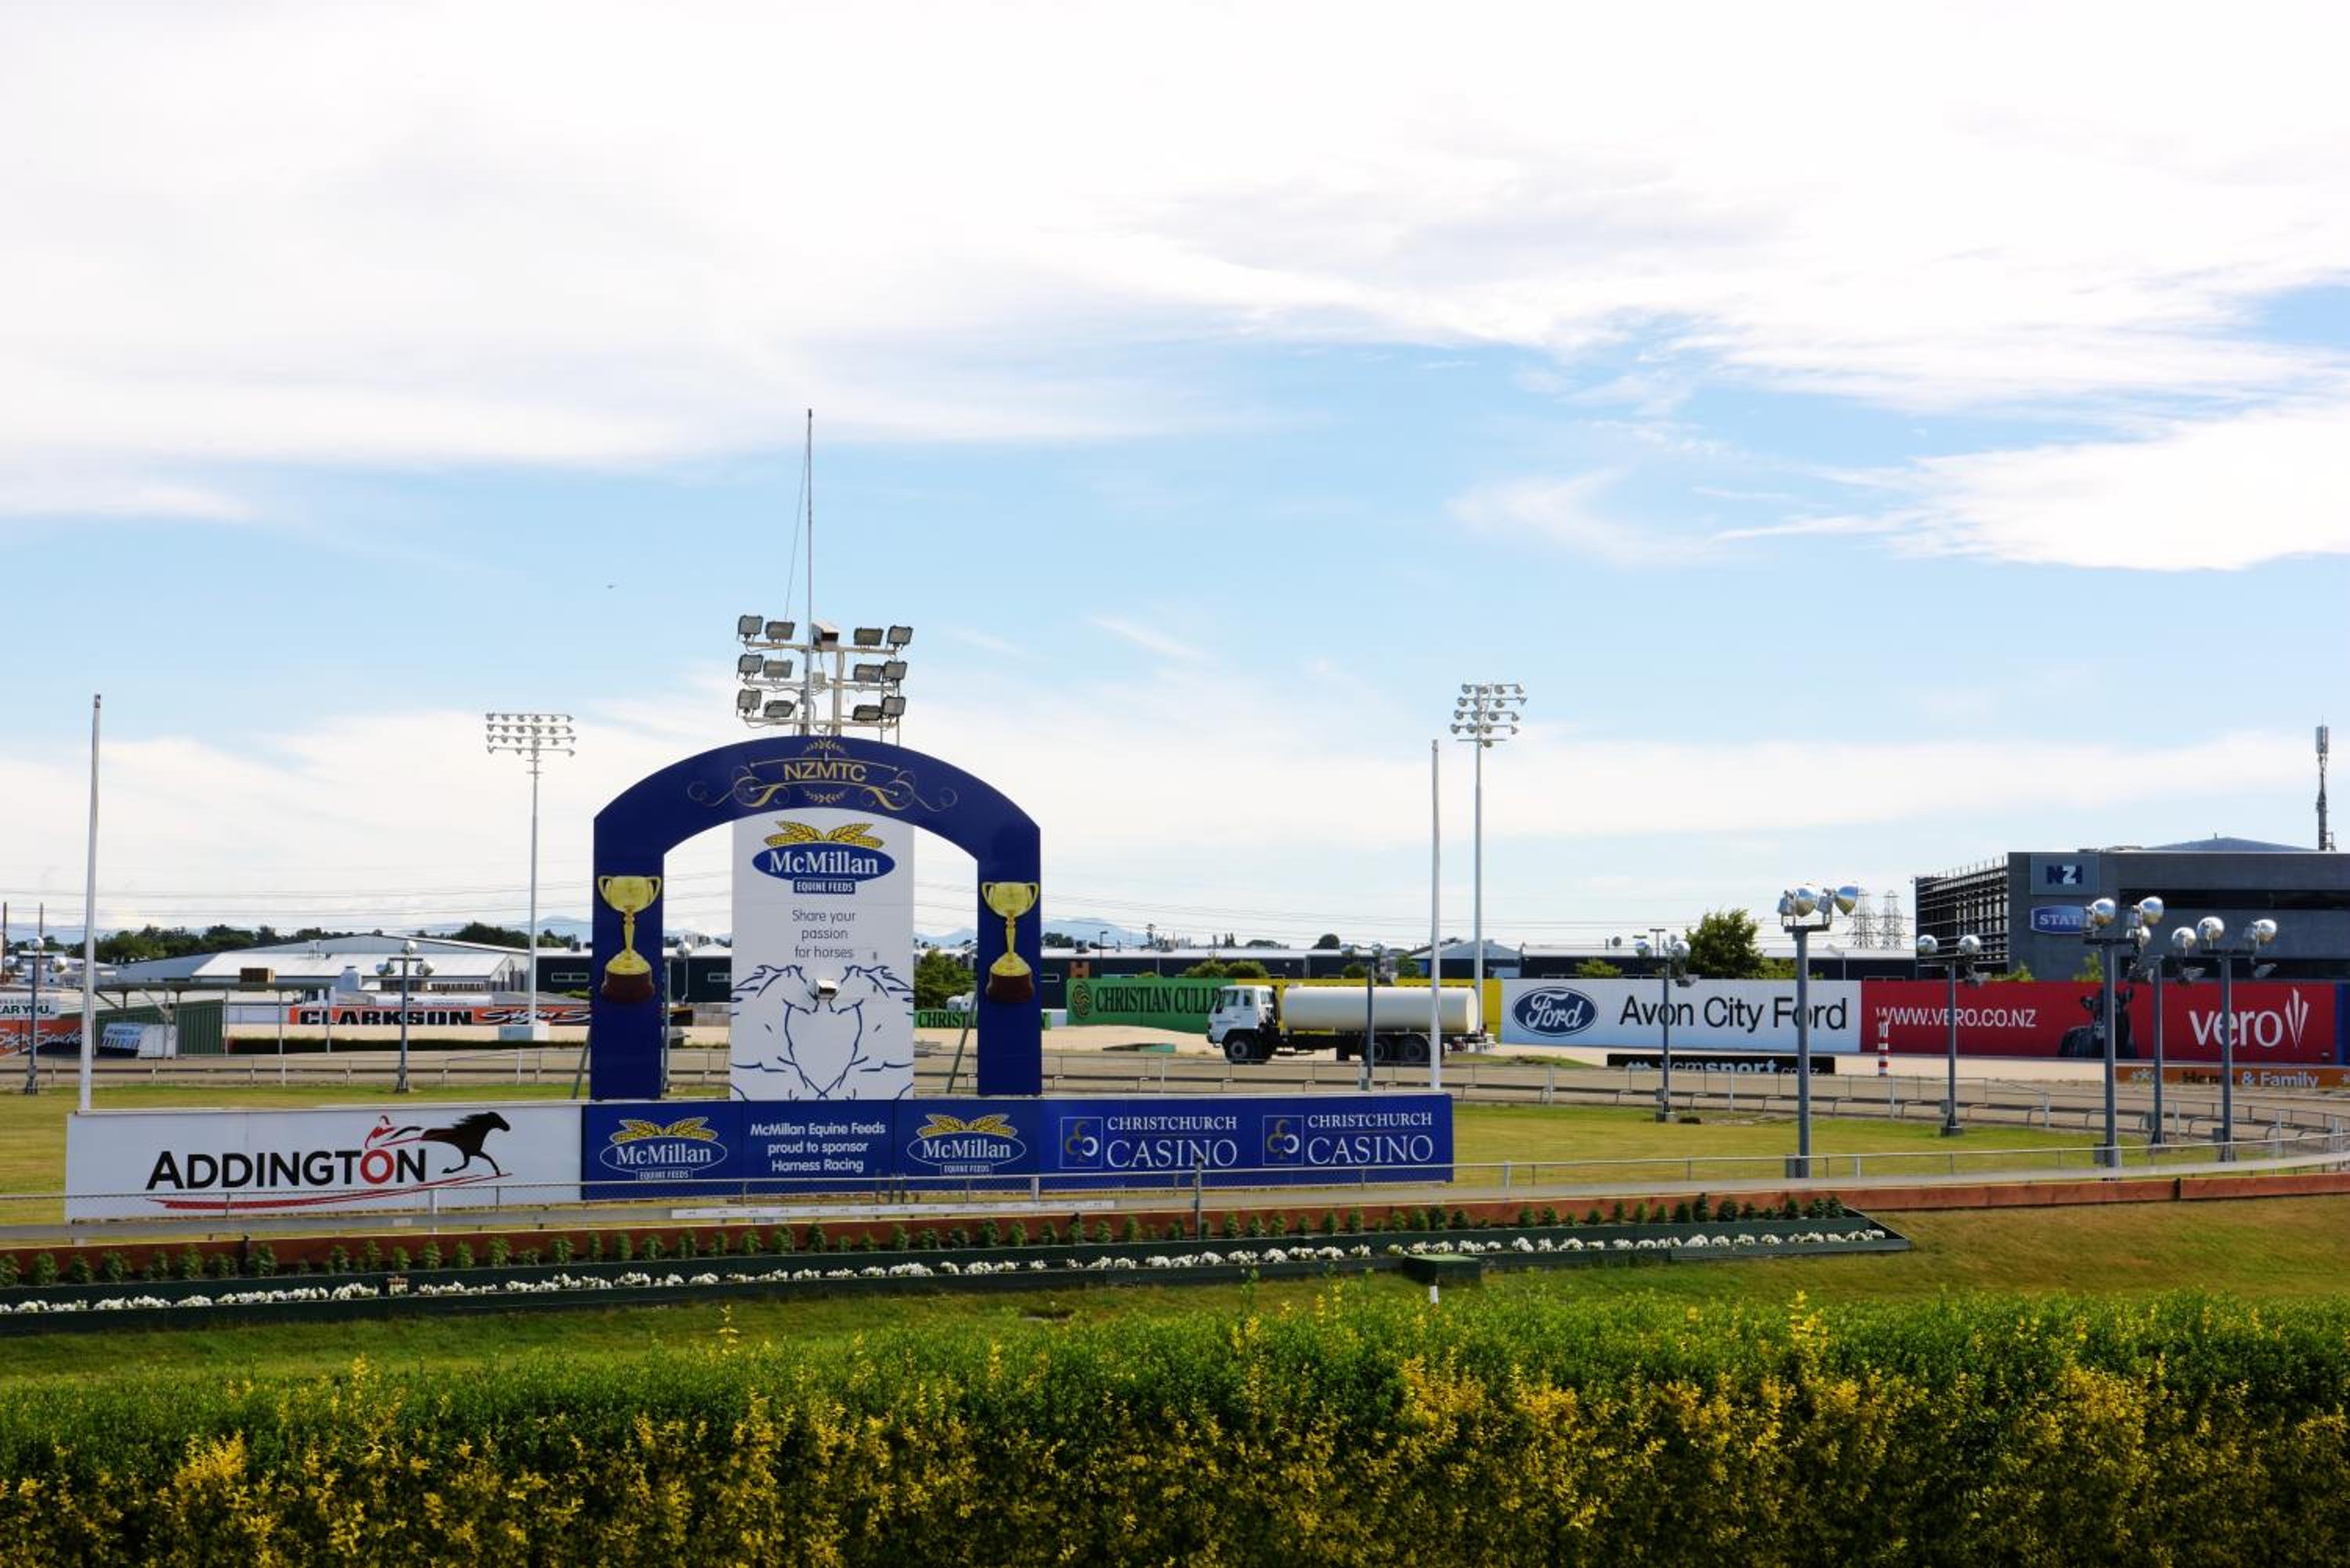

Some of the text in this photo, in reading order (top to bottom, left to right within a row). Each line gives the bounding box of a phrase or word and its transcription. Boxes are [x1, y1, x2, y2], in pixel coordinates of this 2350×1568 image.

[784, 761, 867, 782] NZMTC
[769, 851, 879, 874] McMillan
[797, 881, 853, 892] EQUINE FEEDS
[792, 909, 855, 924] Share your
[2039, 914, 2083, 926] STAT
[801, 927, 848, 941] passion
[794, 945, 854, 958] for horses
[1096, 987, 1219, 1013] CHRISTIAN CULL
[299, 1010, 473, 1025] CLARKSON
[1526, 992, 1585, 1028] Ford
[1619, 995, 1694, 1027] Avon
[1704, 996, 1764, 1033] City
[2189, 1010, 2283, 1048] vero
[2241, 1071, 2255, 1086] &
[2260, 1071, 2319, 1089] Family
[1107, 1116, 1237, 1130] CHRISTCHURCH
[1307, 1112, 1432, 1128] CHRISTCHURCH
[750, 1122, 886, 1137] McMillan Equine Feeds
[616, 1143, 711, 1165] McMillan
[768, 1140, 870, 1157] proud to sponsor
[922, 1139, 1011, 1159] McMillan
[1107, 1139, 1238, 1168] CASINO
[1307, 1135, 1434, 1165] CASINO
[145, 1147, 427, 1190] ADDINGTON
[772, 1158, 864, 1173] Harness Racing
